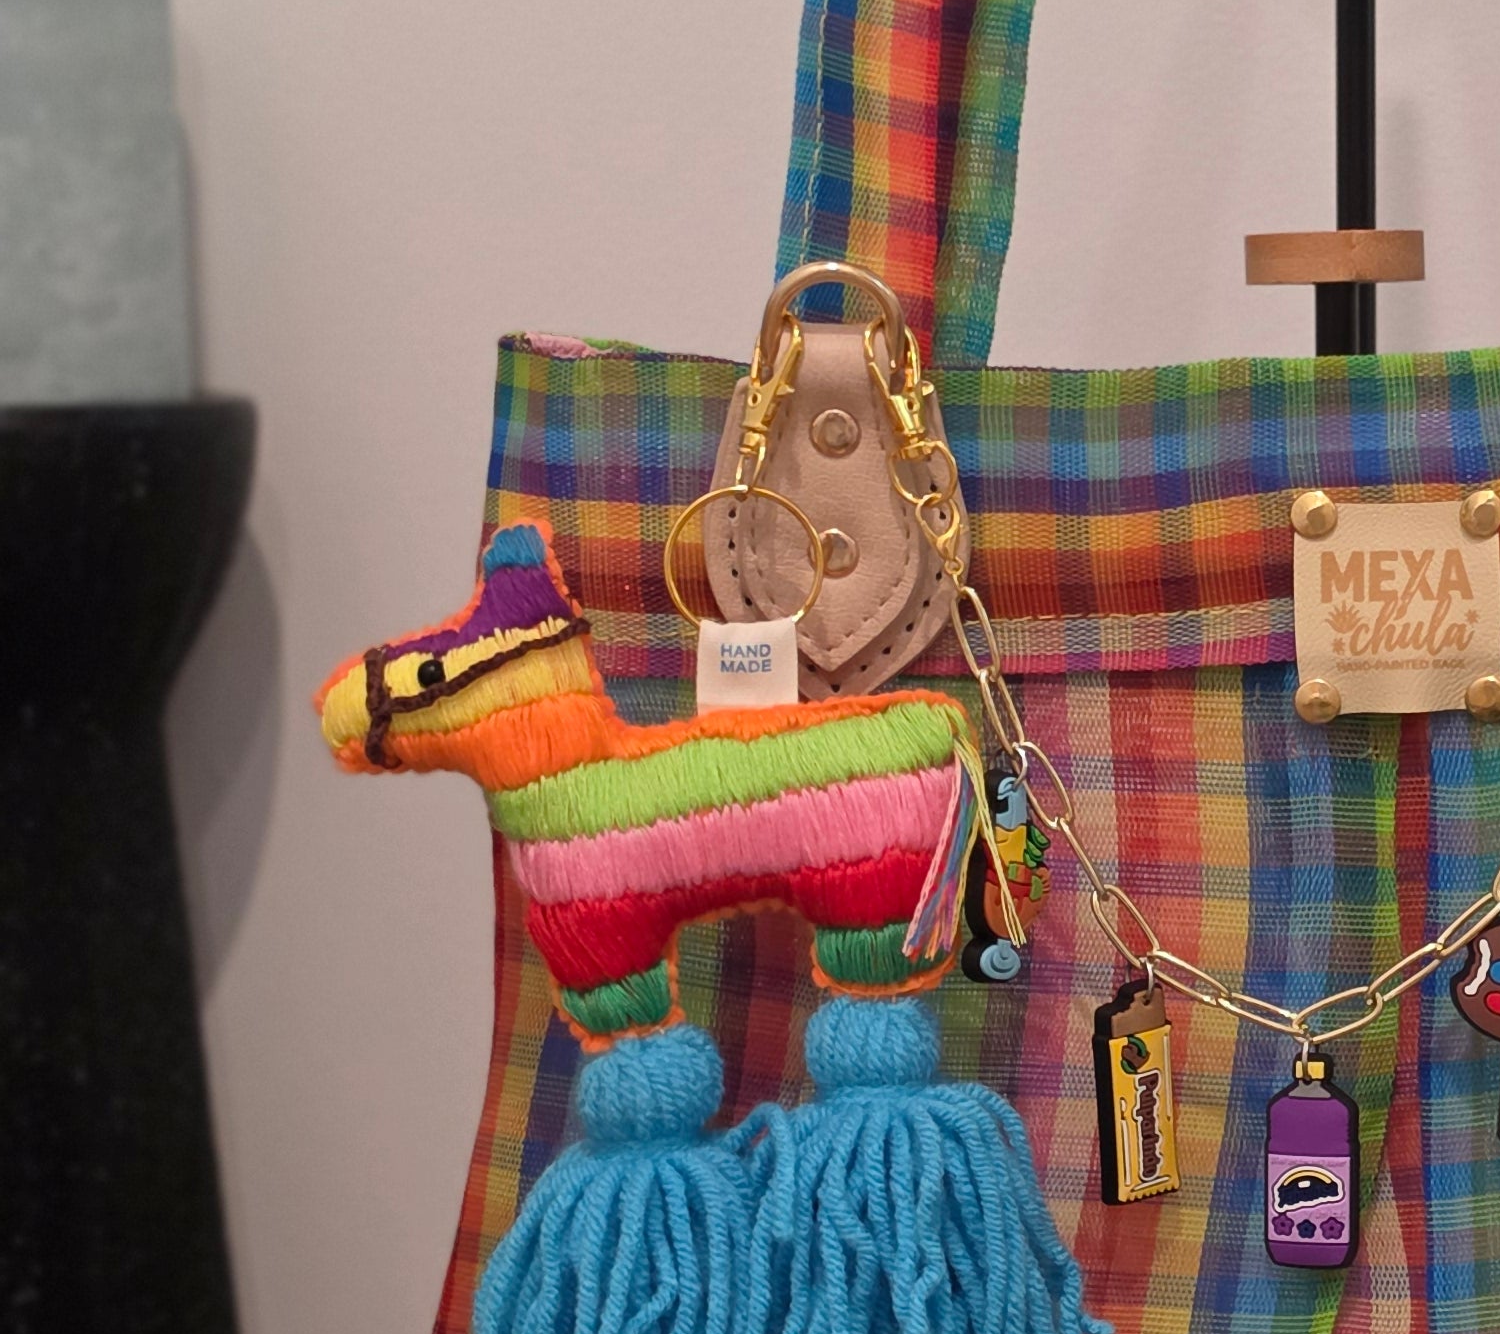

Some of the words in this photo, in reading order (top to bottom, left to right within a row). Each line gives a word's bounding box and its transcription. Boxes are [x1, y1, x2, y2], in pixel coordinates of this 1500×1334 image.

[1320, 549, 1474, 604] MEXA
[1350, 593, 1475, 656] chula
[720, 643, 771, 657] HAND
[720, 659, 772, 673] MADE
